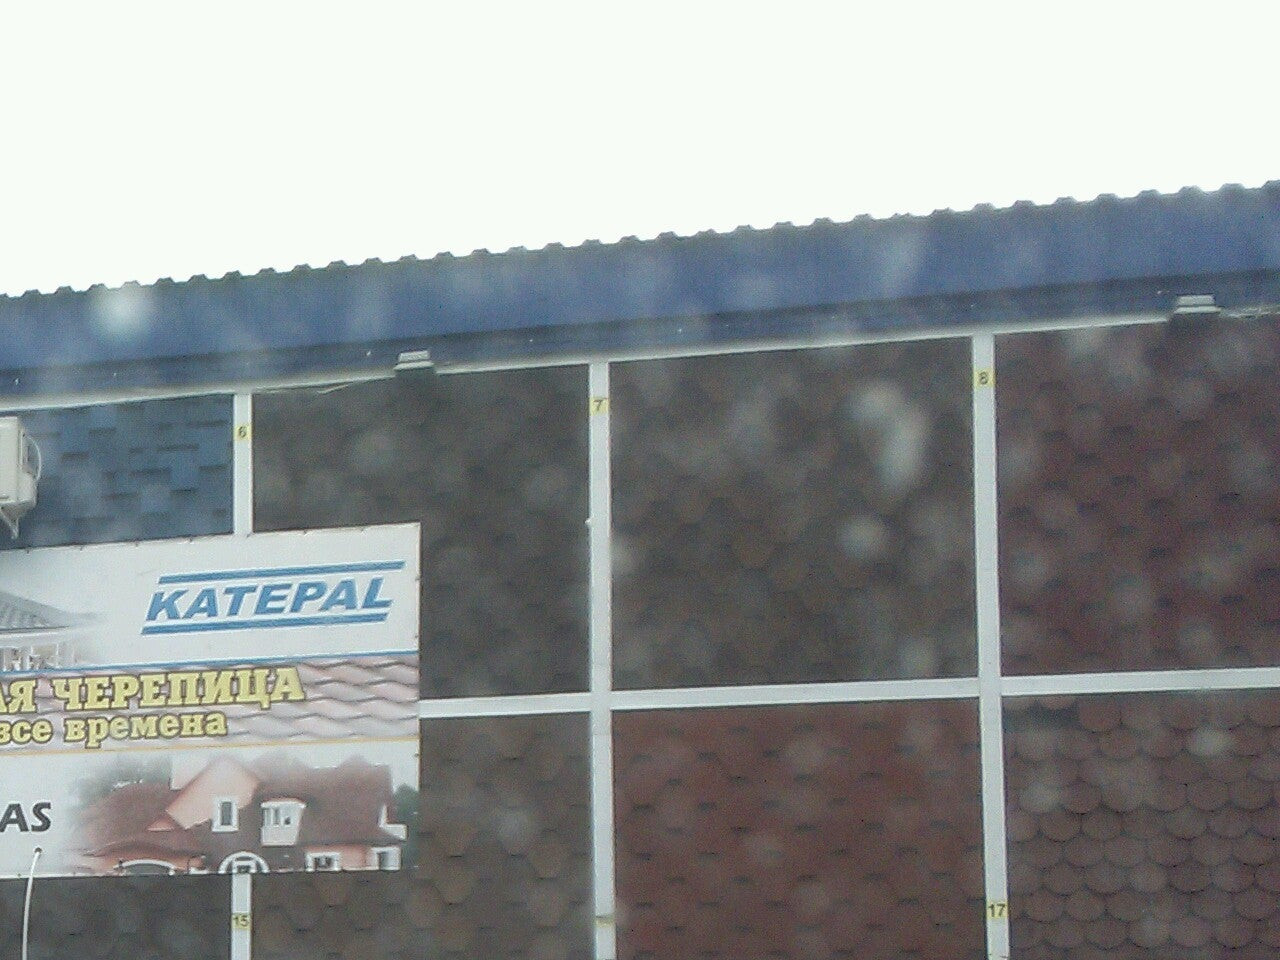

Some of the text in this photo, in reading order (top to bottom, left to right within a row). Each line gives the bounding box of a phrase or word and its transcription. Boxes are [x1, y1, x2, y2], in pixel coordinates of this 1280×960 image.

[979, 372, 988, 386] 8
[593, 399, 603, 412] 7
[238, 426, 247, 439] 6
[145, 576, 394, 621] KATEPAL
[51, 666, 306, 710] ЧЕРЕПИЦА
[63, 710, 227, 749] времена
[988, 903, 1006, 917] 17
[233, 914, 249, 928] 15
